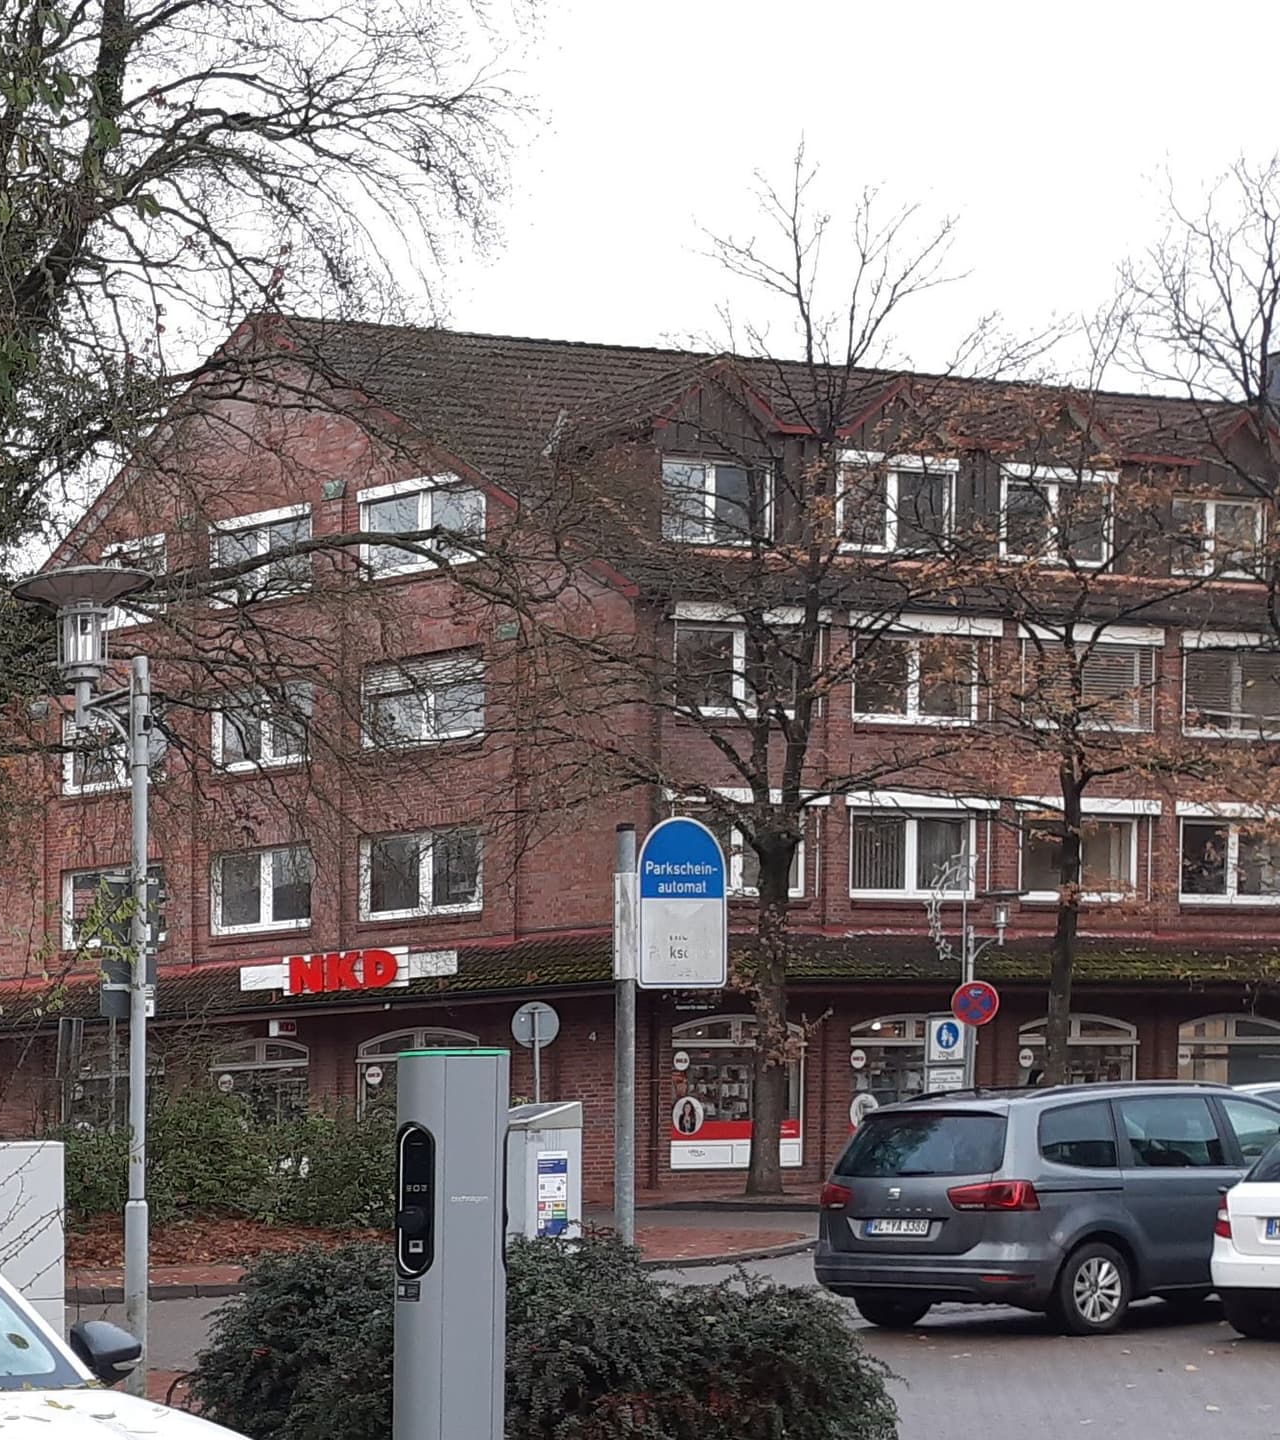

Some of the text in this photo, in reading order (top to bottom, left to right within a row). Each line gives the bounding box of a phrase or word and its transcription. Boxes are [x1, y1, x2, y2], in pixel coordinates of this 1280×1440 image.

[645, 861, 719, 875] Parkschein-
[658, 880, 707, 894] automat
[289, 949, 398, 996] NKD
